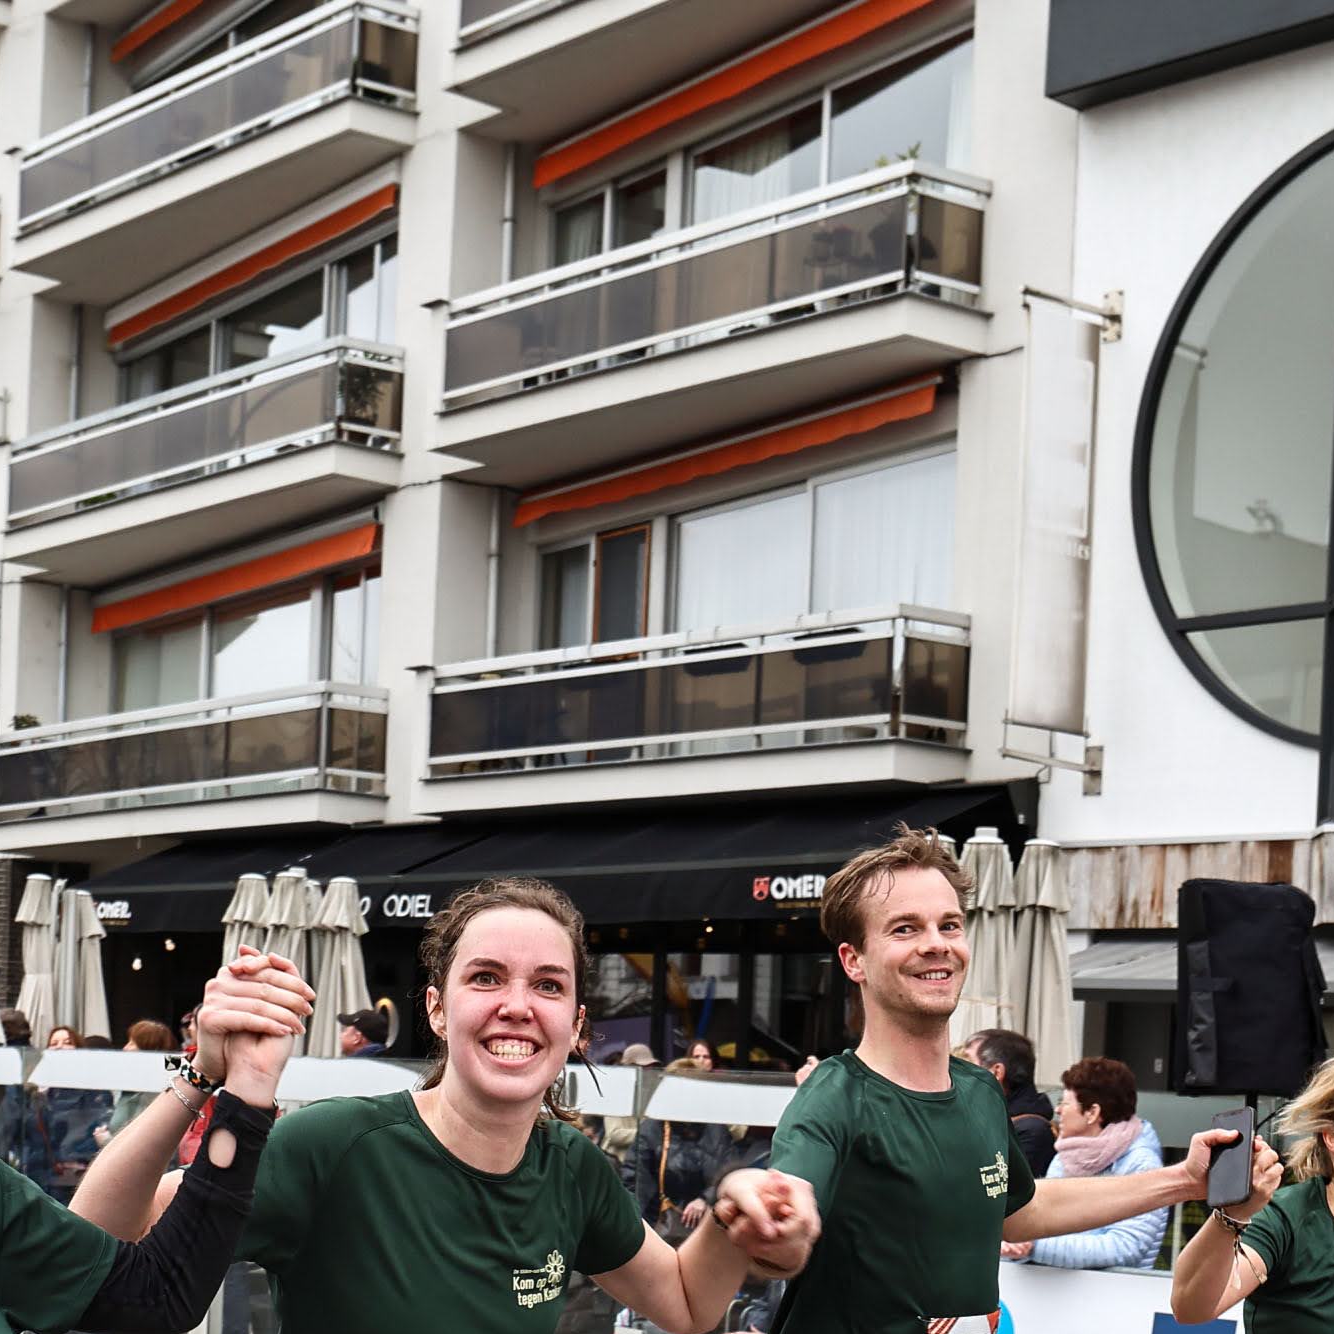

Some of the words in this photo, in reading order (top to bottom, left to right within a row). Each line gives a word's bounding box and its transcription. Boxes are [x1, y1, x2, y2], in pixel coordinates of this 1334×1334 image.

[383, 894, 434, 917] ODIEL
[512, 1276, 535, 1291] Kom
[536, 1277, 547, 1291] op
[517, 1292, 543, 1309] tegen
